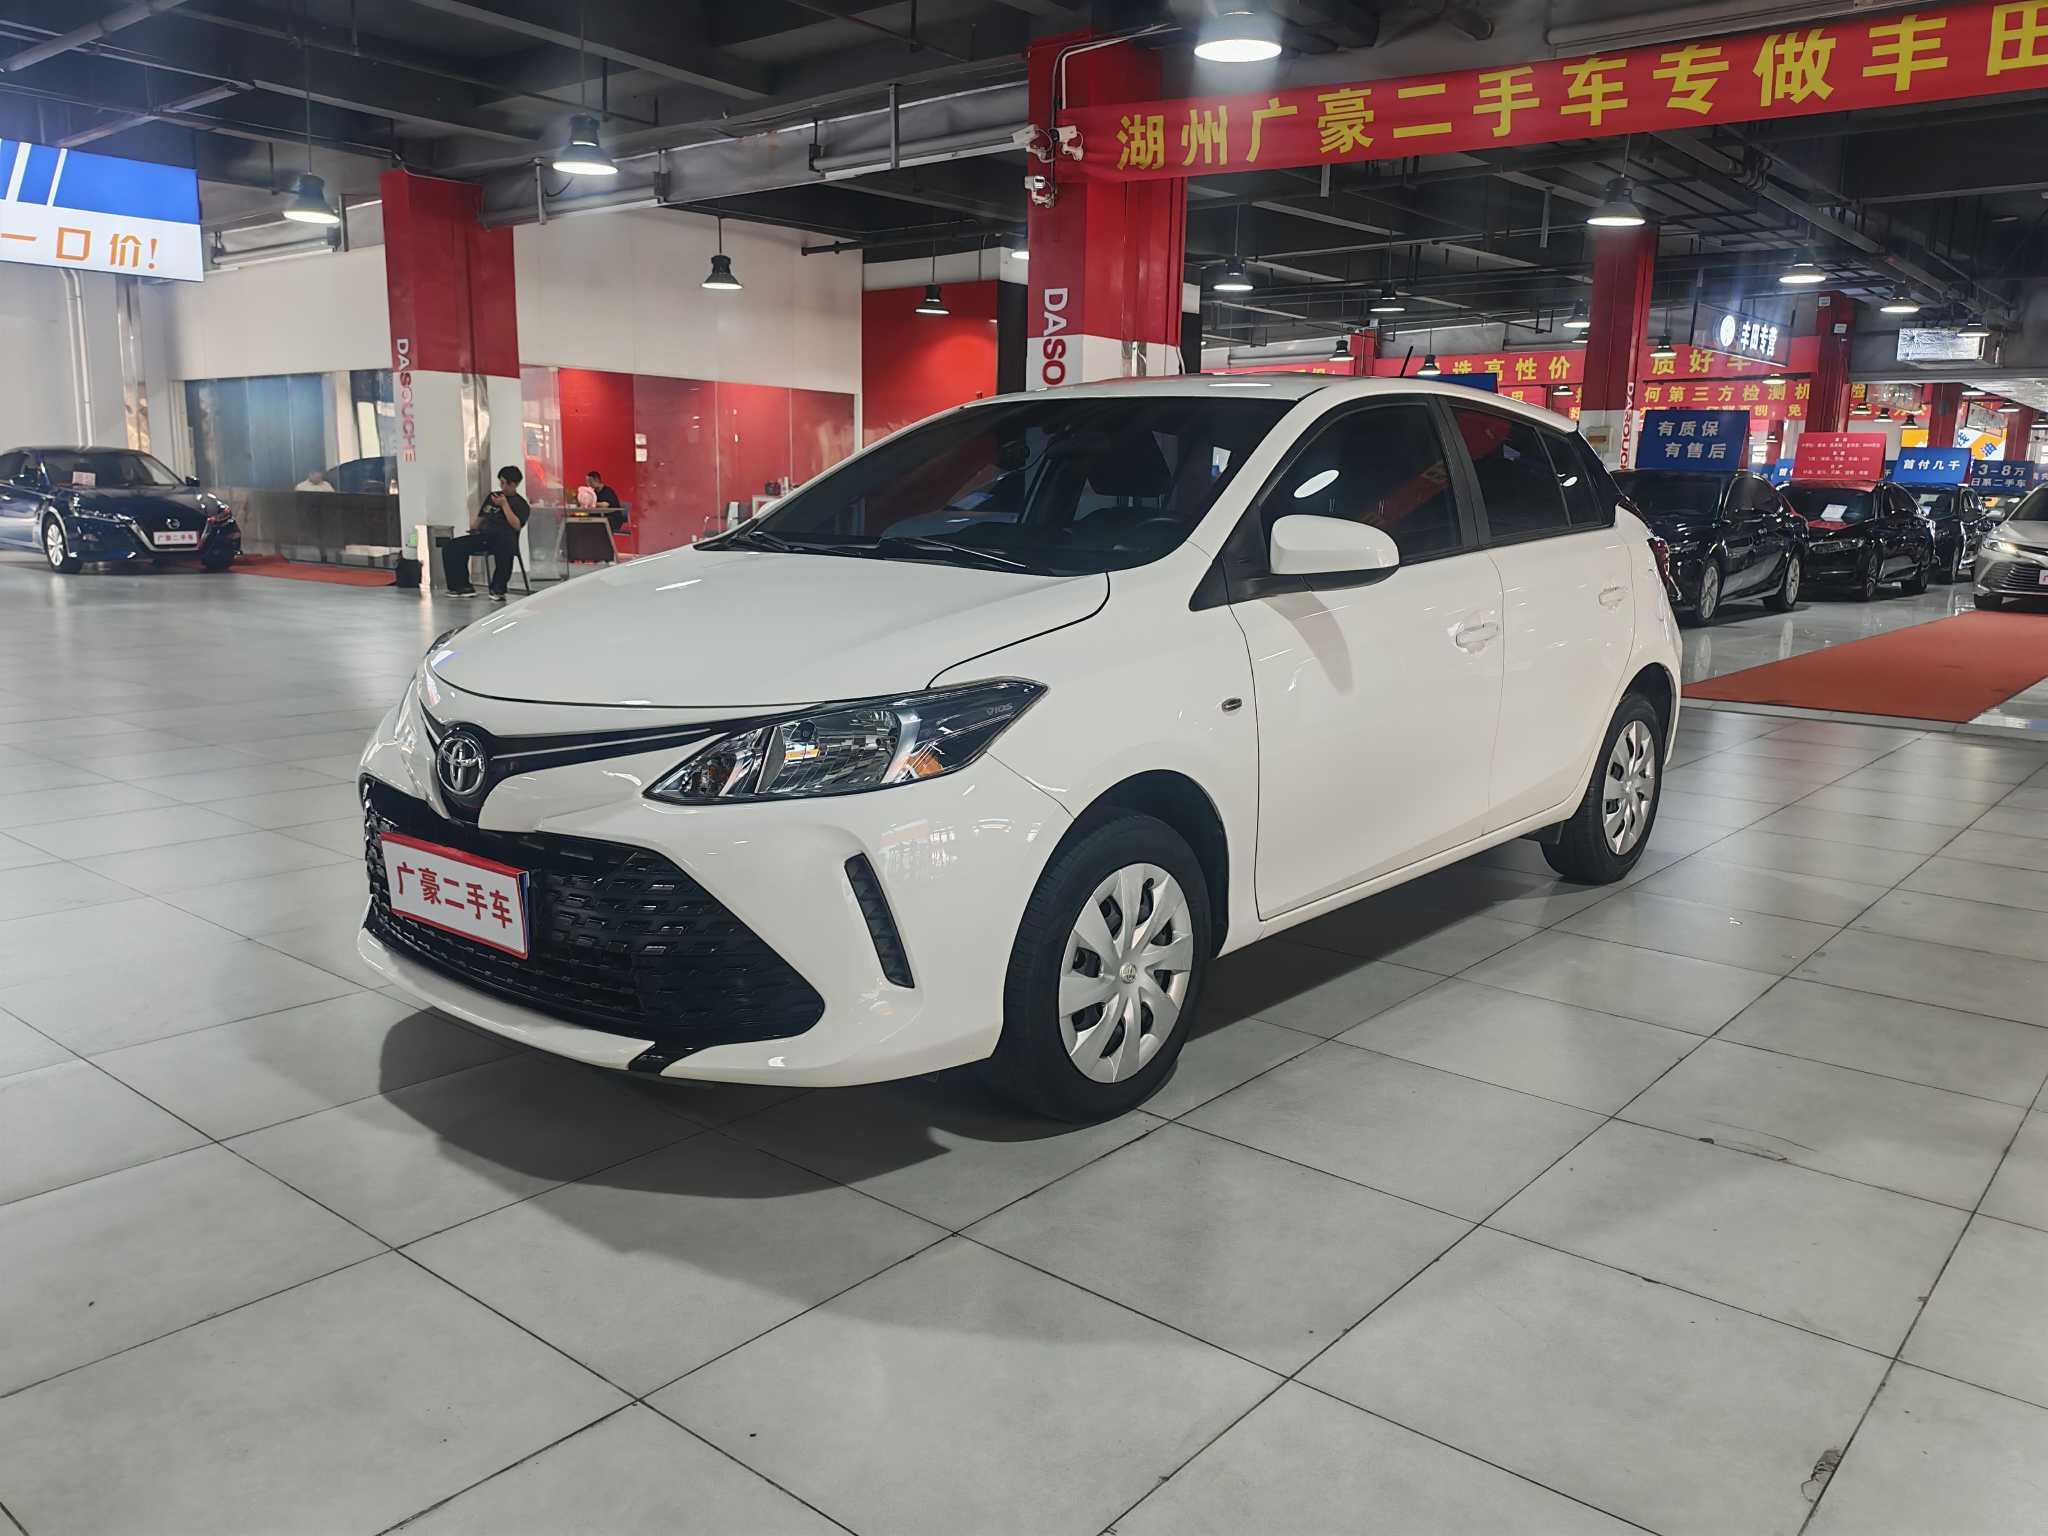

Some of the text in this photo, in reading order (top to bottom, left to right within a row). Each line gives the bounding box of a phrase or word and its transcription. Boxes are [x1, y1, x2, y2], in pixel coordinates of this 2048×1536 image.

[1116, 1, 2048, 171] 湖州广豪二手车专做丰田
[1657, 420, 1720, 437] 有质保
[1664, 443, 1727, 459] 有售后
[1903, 458, 1961, 471] 首付几千
[396, 861, 513, 929] 广豪二手车
